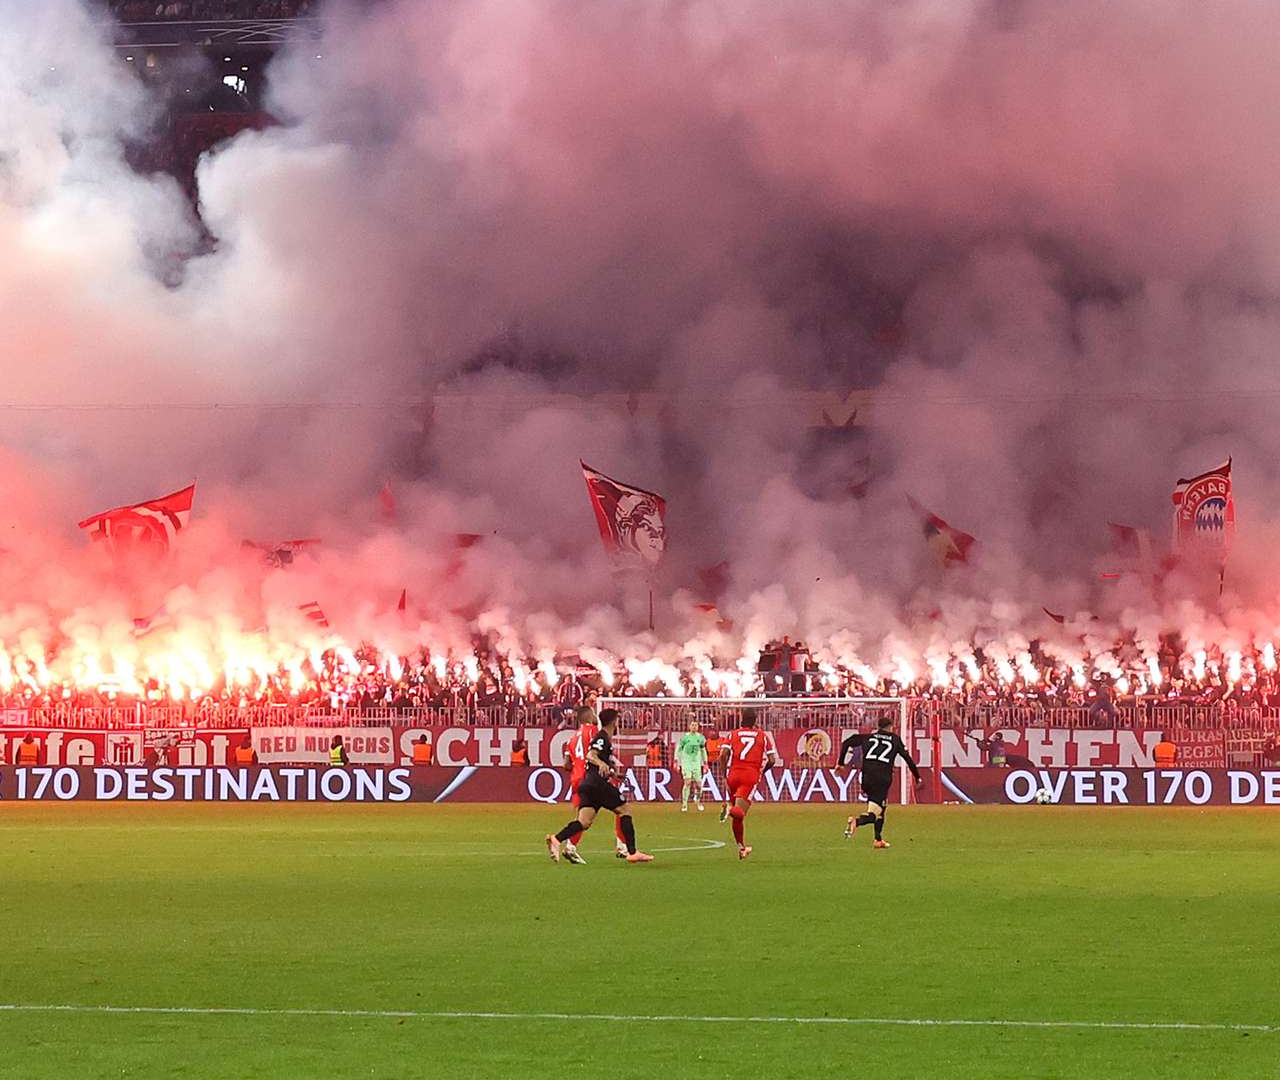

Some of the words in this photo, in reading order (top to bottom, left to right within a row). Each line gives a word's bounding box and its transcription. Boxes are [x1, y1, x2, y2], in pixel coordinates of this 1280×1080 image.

[260, 736, 297, 753] RED
[740, 737, 755, 760] 7
[865, 738, 893, 763] 22
[16, 767, 80, 800] 170
[94, 767, 412, 801] DESTINATIONS
[1005, 770, 1129, 804] OVER
[1143, 771, 1212, 804] 170
